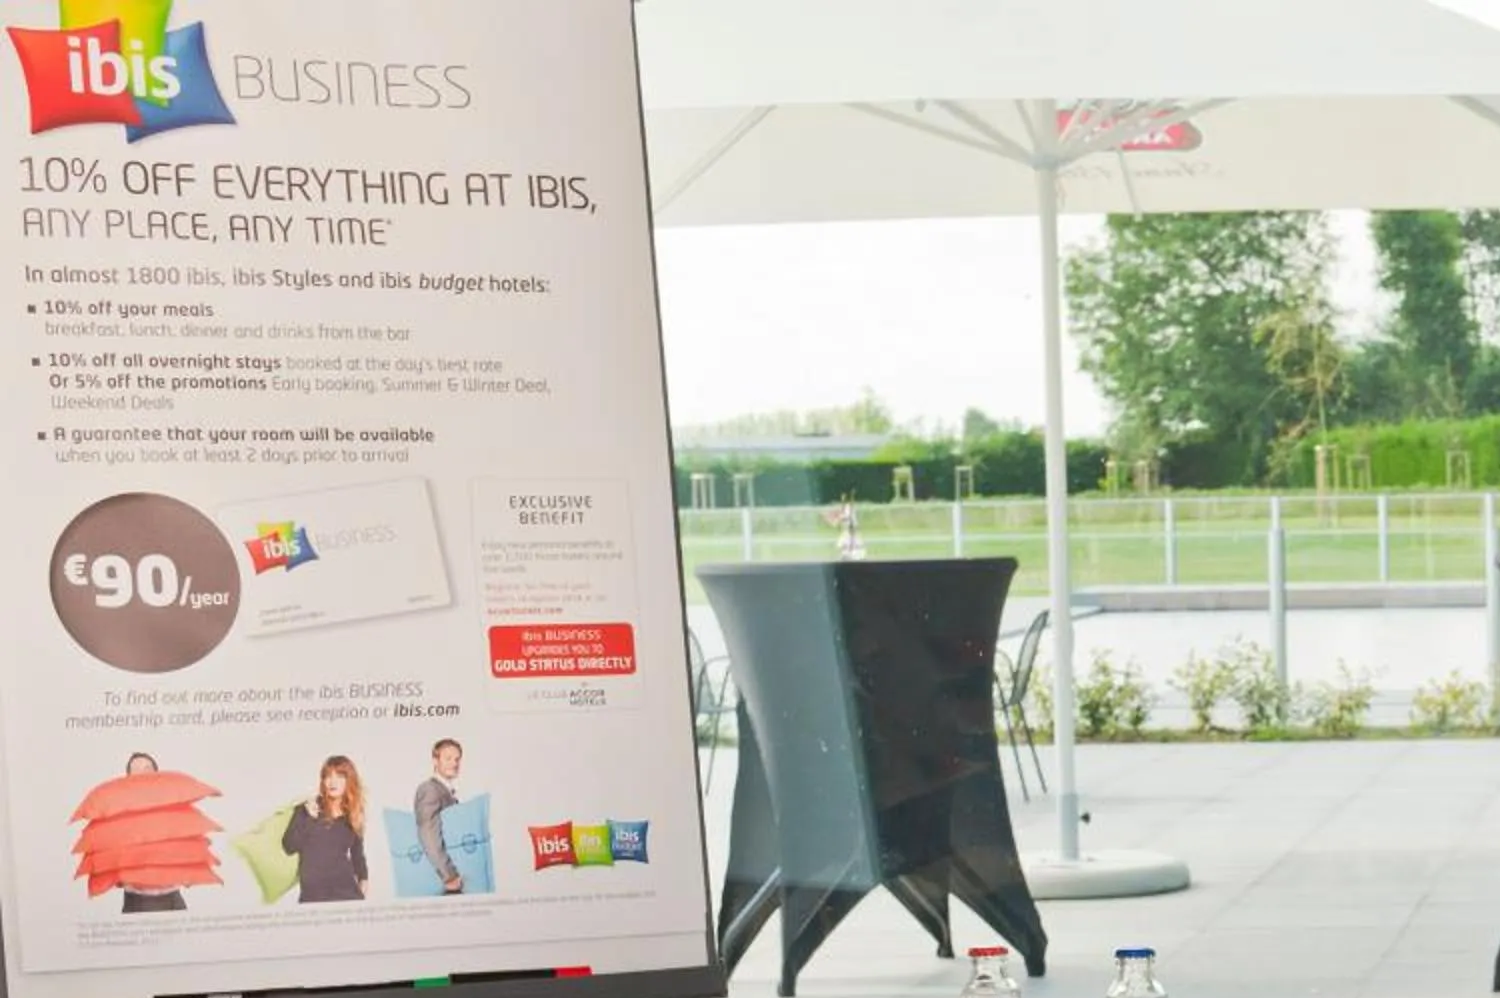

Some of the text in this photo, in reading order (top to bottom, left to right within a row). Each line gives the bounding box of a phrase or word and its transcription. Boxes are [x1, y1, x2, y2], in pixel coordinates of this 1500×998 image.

[67, 36, 471, 109] ibis BUSINESS
[20, 156, 597, 214] 10% OFF EVERYTHING AT IBIS,
[23, 208, 90, 237] ANY
[105, 209, 217, 243] PLACE,
[229, 214, 293, 242] ANY
[25, 265, 43, 284] In
[51, 266, 119, 285] almost
[127, 267, 180, 285] 1800
[233, 269, 266, 286] ibis
[271, 269, 332, 291] Styles
[339, 271, 373, 289] and
[380, 271, 412, 289] ibis
[419, 272, 483, 294] budget
[489, 273, 551, 293] hotels:
[44, 300, 214, 319] 10% off your meals
[180, 324, 228, 338] dinner
[234, 324, 263, 339] and
[267, 324, 314, 339] drinks
[318, 325, 354, 340] from
[357, 326, 382, 341] the
[387, 326, 410, 341] bar
[49, 353, 86, 368] 10%
[92, 353, 116, 367] off
[123, 353, 143, 368] all
[150, 354, 231, 371] overnight
[236, 355, 282, 373] stays
[286, 356, 343, 371] booked
[346, 358, 360, 371] at
[365, 357, 391, 371] the
[49, 374, 68, 389] Or
[75, 374, 100, 389] 5%
[107, 374, 132, 389] off
[137, 374, 166, 389] the
[171, 375, 267, 391] promotions
[271, 377, 311, 394] Early
[383, 378, 441, 393] Summer
[463, 378, 510, 393] Winter
[50, 395, 175, 411] Weekend Deals
[53, 427, 435, 445] A guarantee that your room will be available
[55, 447, 409, 465] when you book at least 2 days prior to arrival
[509, 495, 593, 509] EXCLUSIVE
[519, 511, 584, 525] BENEFIT
[263, 537, 301, 559] ibis
[103, 681, 424, 706] To find out more about the ibis BUSINESS
[65, 710, 164, 729] membership
[210, 709, 262, 726] please
[266, 709, 293, 722] see
[299, 705, 369, 723] reception
[373, 706, 388, 718] or
[394, 702, 461, 718] ibis.com
[537, 834, 570, 855] ibis
